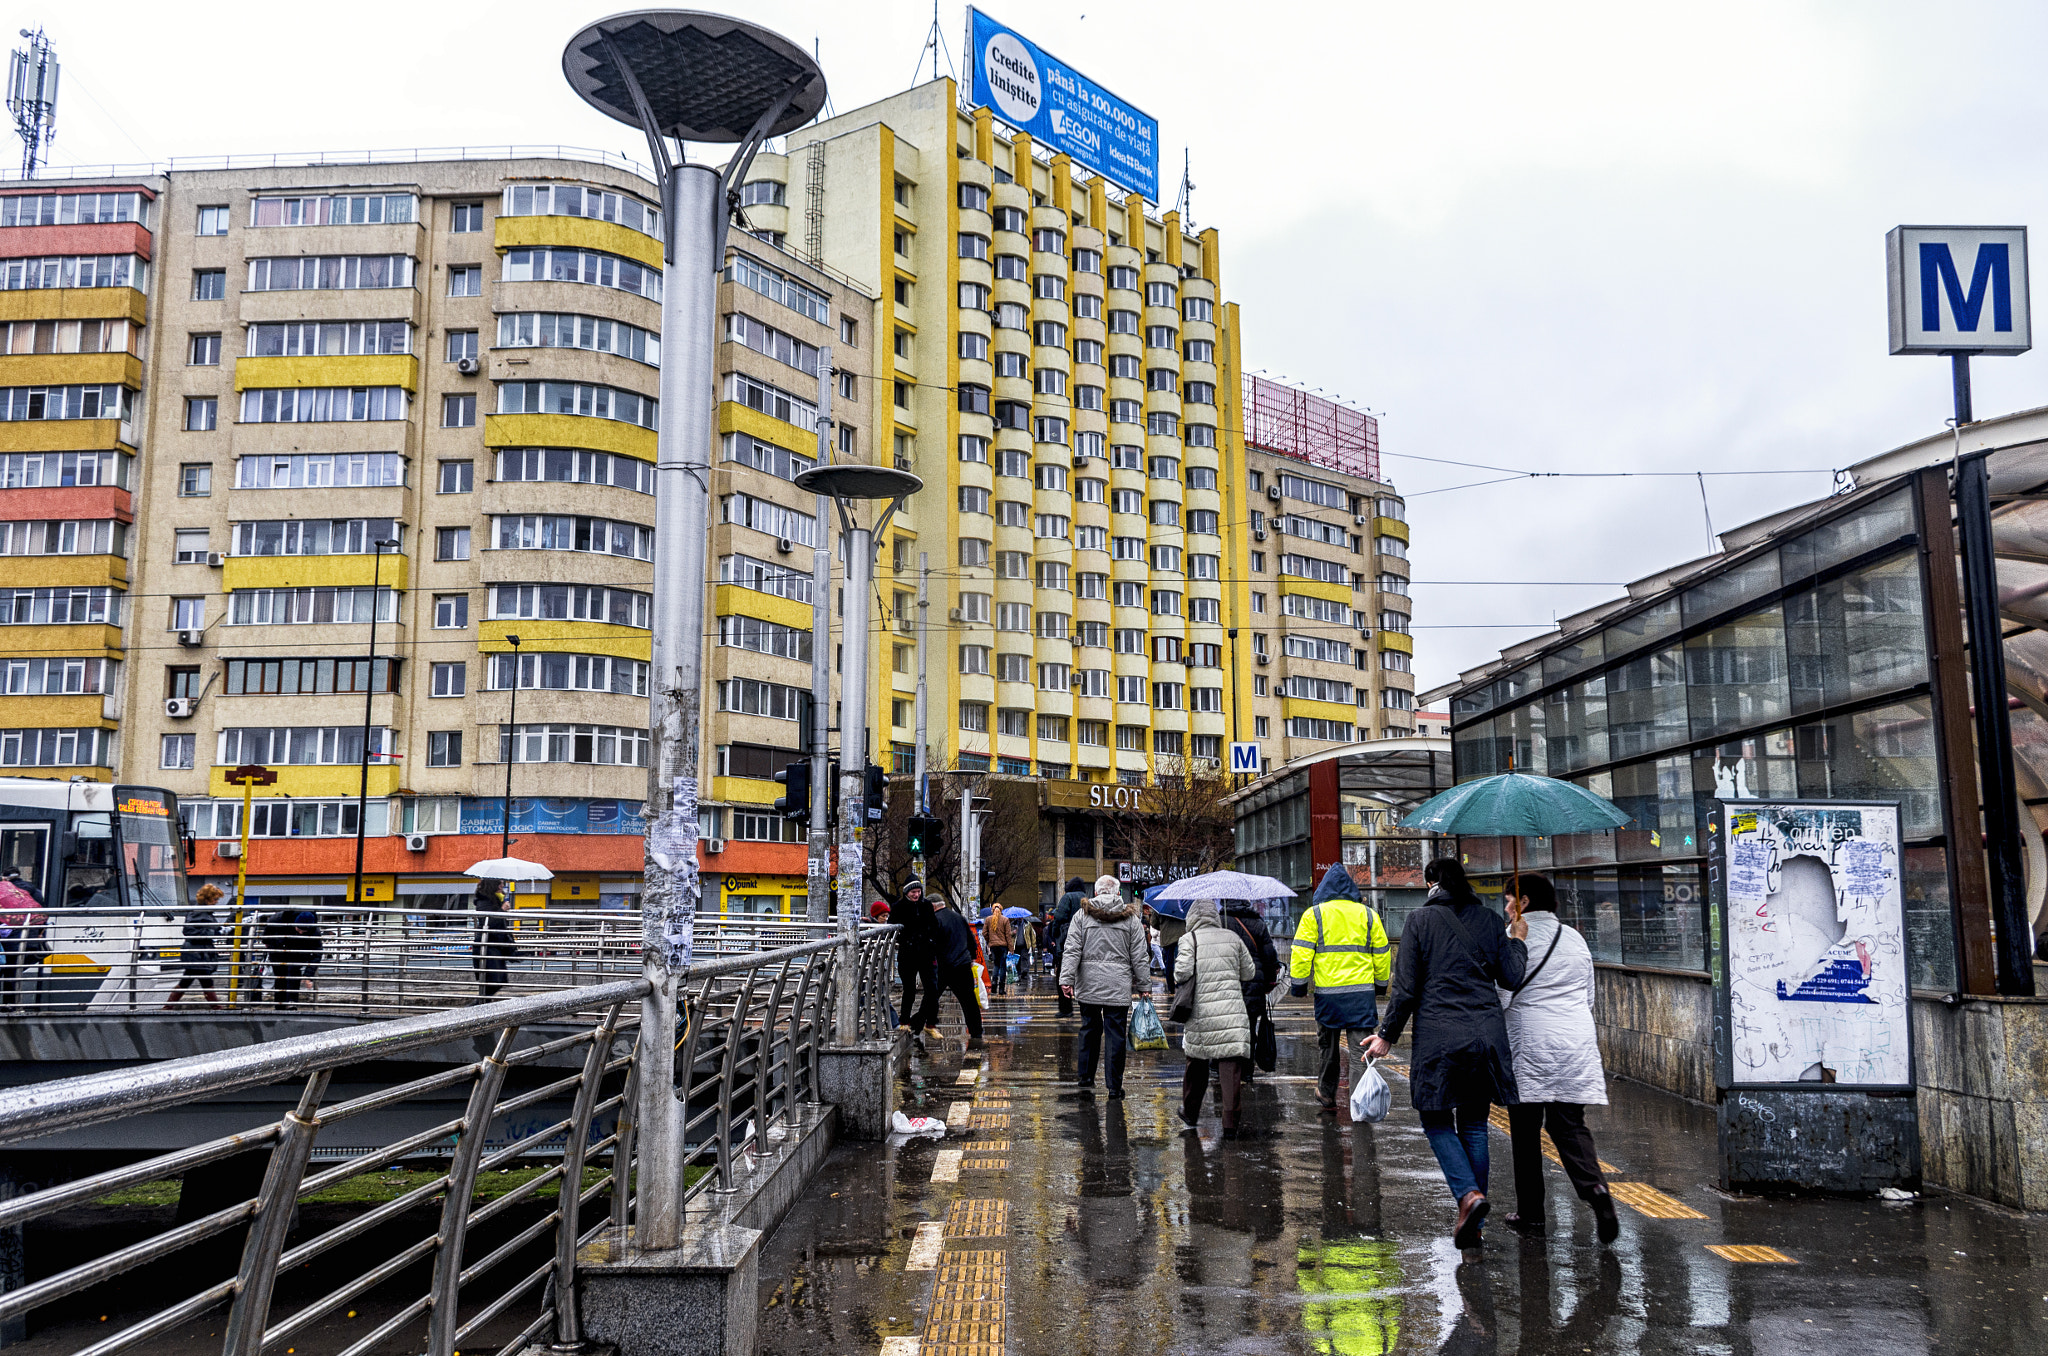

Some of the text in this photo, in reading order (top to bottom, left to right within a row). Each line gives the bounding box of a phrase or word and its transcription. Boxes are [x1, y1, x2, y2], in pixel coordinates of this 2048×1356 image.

[992, 46, 1035, 84] Credite
[1047, 67, 1151, 141] până la 100.000 lei
[1052, 90, 1064, 105] cu
[1067, 98, 1113, 134] asigurare
[1114, 125, 1126, 141] de
[1109, 144, 1153, 179] Idea Bank
[1919, 242, 2012, 333] M
[1234, 745, 1257, 769] M
[1091, 785, 1142, 809] SLOT
[461, 818, 501, 826] CABINET
[737, 879, 758, 890] punkt
